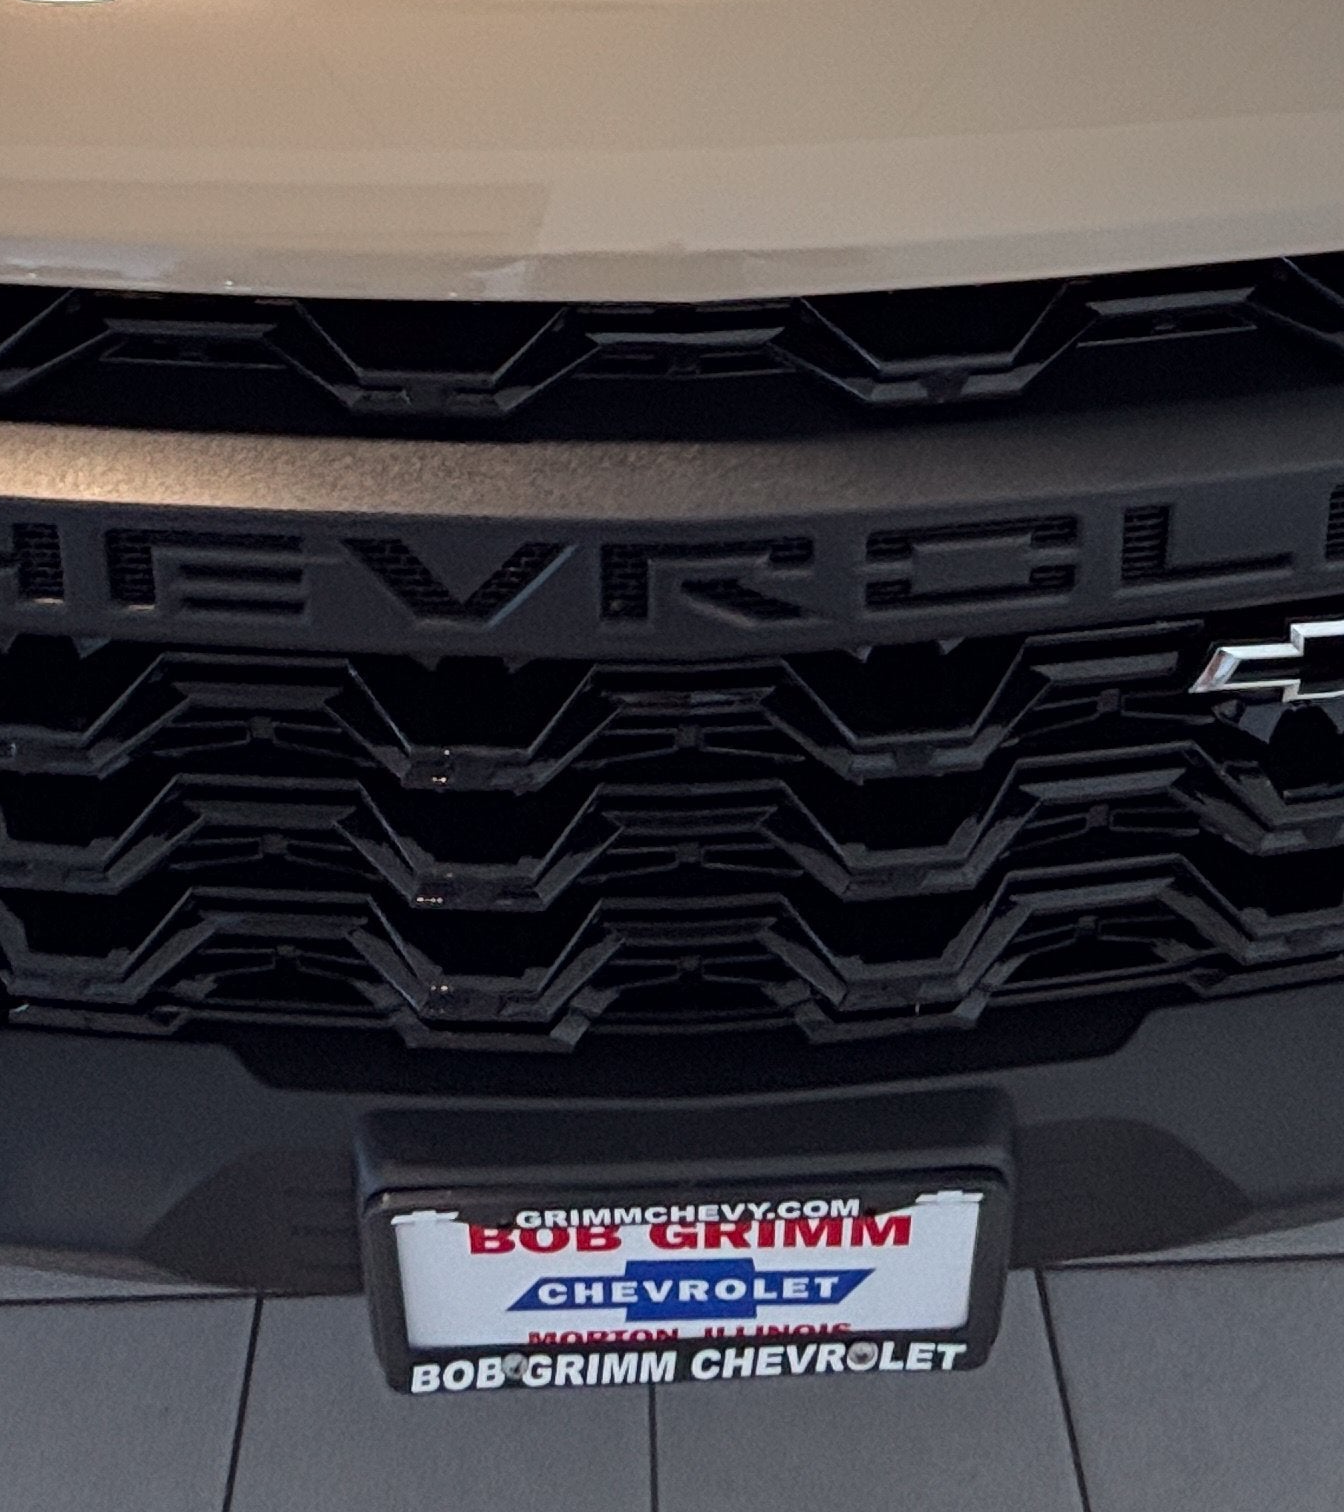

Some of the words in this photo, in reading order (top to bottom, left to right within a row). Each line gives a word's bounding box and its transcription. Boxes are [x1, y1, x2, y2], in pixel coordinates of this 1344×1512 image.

[516, 1198, 860, 1229] GRIMMCHEVY.COM
[468, 1223, 622, 1255] BOB
[649, 1214, 912, 1250] GRIMM
[538, 1276, 839, 1305] CHEVROLET
[411, 1356, 506, 1394] BOB
[522, 1350, 677, 1388] GRIMM
